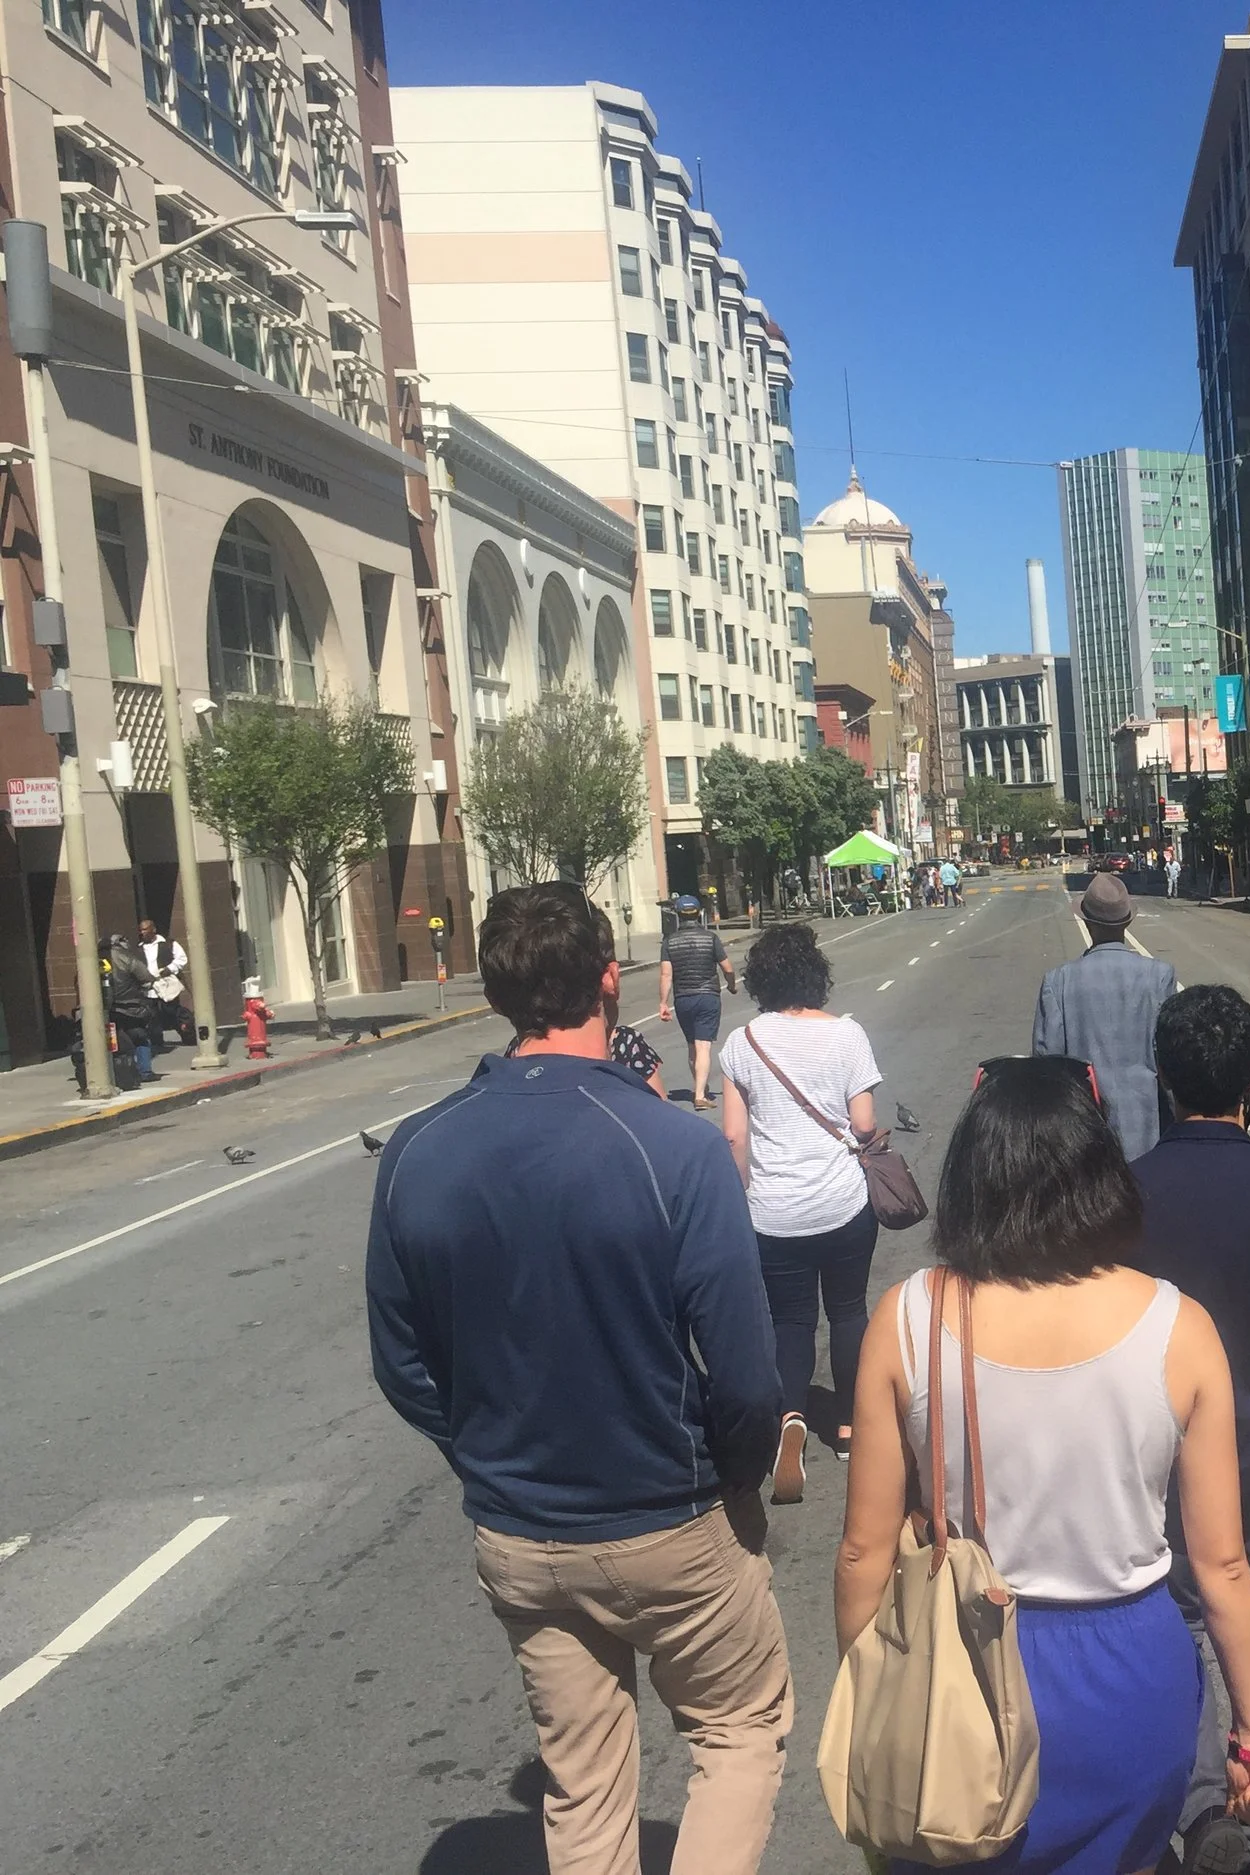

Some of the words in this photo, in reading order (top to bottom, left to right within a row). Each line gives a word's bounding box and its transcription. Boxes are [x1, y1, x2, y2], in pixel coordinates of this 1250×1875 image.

[188, 422, 207, 450] ST.
[210, 433, 264, 474] ANTHONY
[266, 456, 330, 500] FOUNDATION
[10, 781, 24, 793] NO
[26, 783, 56, 792] PARKING
